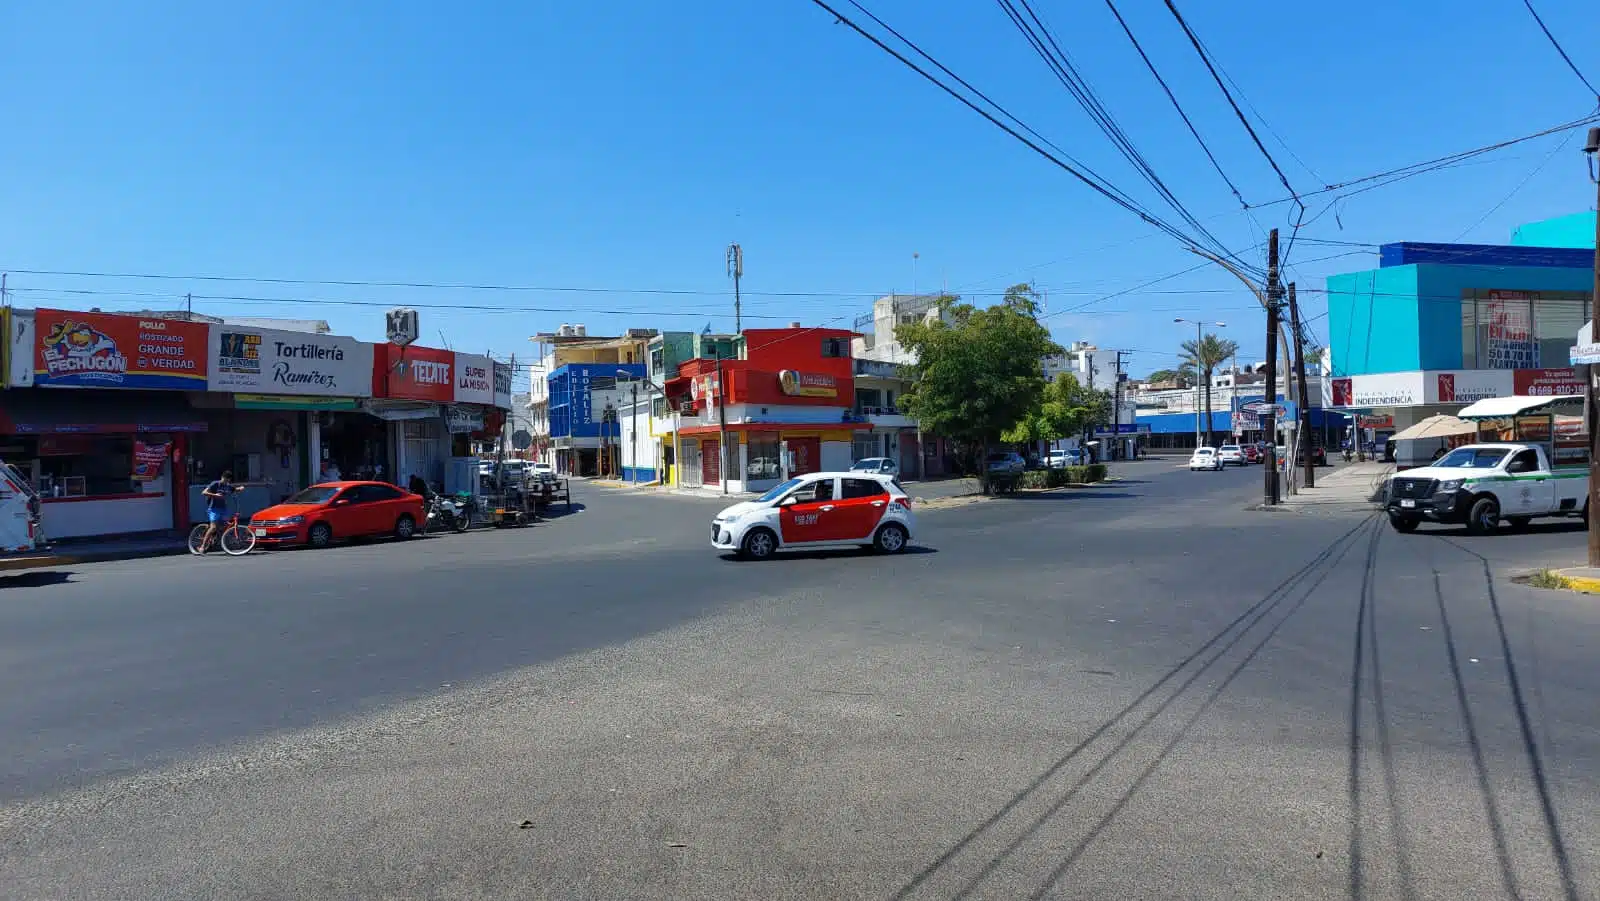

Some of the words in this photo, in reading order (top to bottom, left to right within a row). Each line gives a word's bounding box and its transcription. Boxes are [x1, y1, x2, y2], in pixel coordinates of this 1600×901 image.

[139, 321, 166, 329] POLLO
[45, 349, 64, 361] EL
[139, 344, 185, 355] GRANDE
[274, 342, 344, 361] Tortillería
[47, 350, 126, 373] PECHUGÓN
[151, 358, 195, 368] VERDAD
[411, 360, 450, 384] TECATE
[465, 364, 485, 377] SUPER
[1356, 395, 1413, 406] INDEPENDENCIA
